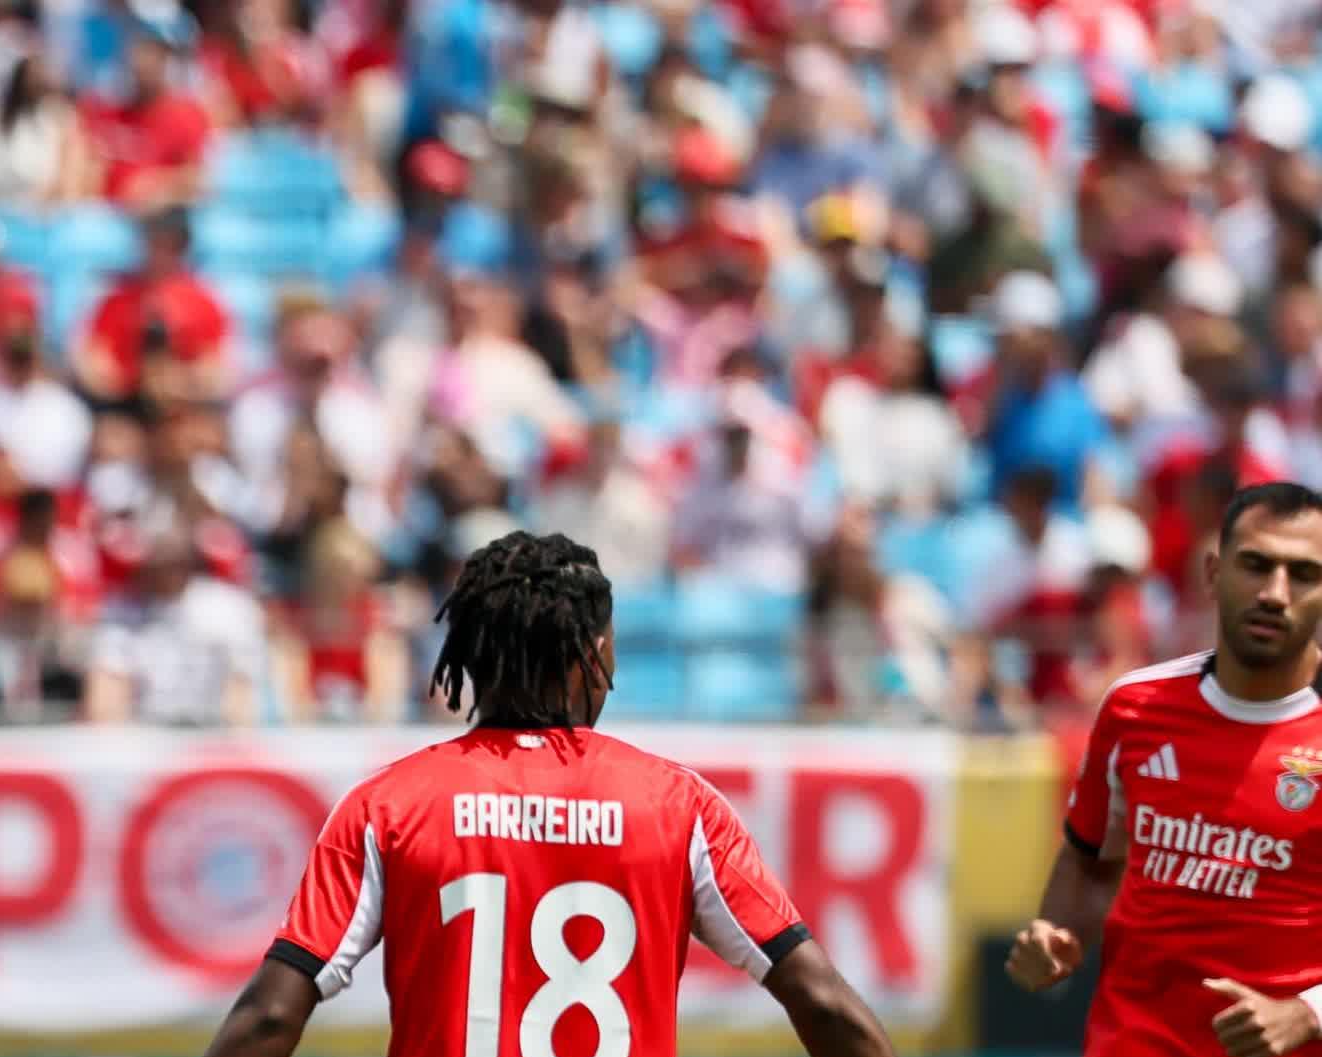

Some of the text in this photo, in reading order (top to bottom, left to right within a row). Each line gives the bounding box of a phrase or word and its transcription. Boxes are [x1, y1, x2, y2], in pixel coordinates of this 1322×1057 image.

[453, 793, 624, 846] BARREIRO
[1135, 803, 1294, 871] Emirates
[1143, 849, 1259, 899] FLY BETTER
